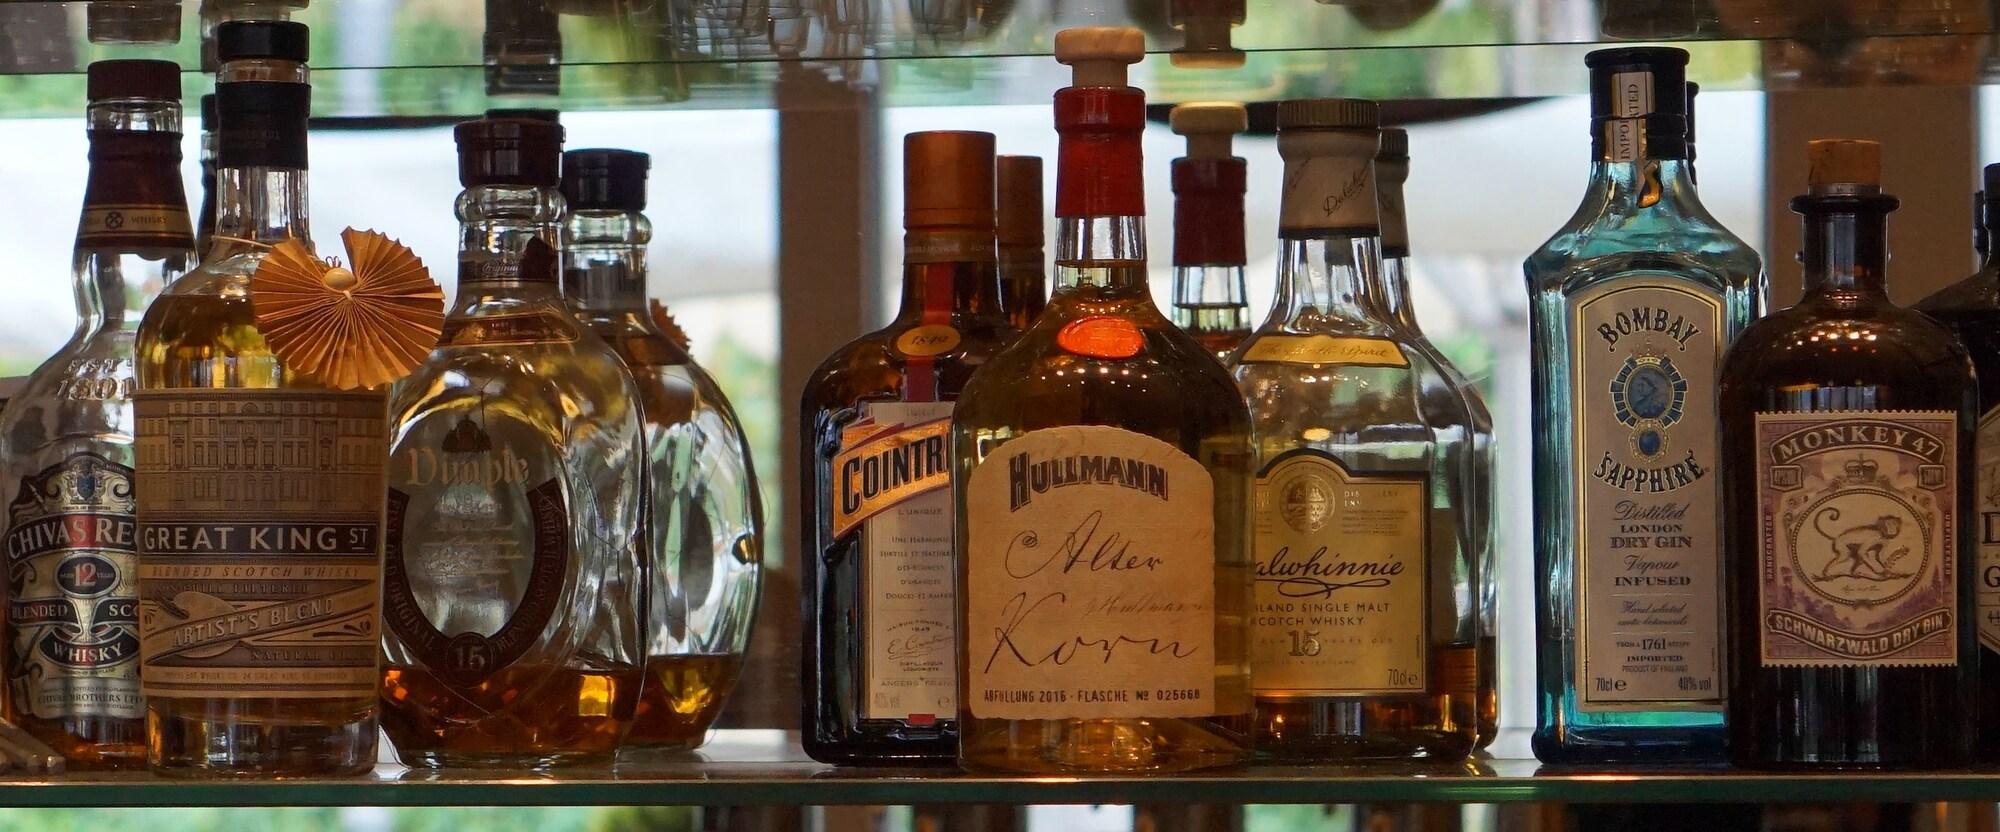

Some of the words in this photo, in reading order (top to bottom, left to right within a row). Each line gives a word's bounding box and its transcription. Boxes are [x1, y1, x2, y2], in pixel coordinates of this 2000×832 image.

[1597, 308, 1700, 352] BOMBAY
[1779, 426, 1908, 460] MONKEY
[1912, 437, 1940, 457] 47
[406, 446, 529, 492] Dimple
[1592, 448, 1705, 494] SAPPHIRE
[1009, 452, 1168, 512] HULLMANN
[1614, 500, 1690, 521] Distilled
[9, 520, 87, 559] CHIVAS
[96, 518, 134, 545] RE
[145, 527, 234, 550] GREAT
[250, 527, 337, 550] KING
[350, 528, 368, 544] ST
[1621, 524, 1682, 533] LONDON
[1005, 510, 1164, 579] Alter
[1610, 536, 1651, 549] DRY
[1655, 536, 1692, 549] GIN
[152, 566, 213, 576] BLENDED
[222, 566, 292, 577] SCOTCH
[303, 566, 359, 577] WHISKY
[1256, 546, 1405, 576] alwhinnie
[1623, 554, 1680, 574] Vapour
[74, 562, 97, 587] 12
[1615, 577, 1691, 586] INFUSED
[12, 604, 68, 618] BLENDED
[1302, 604, 1349, 613] SINGLE
[1357, 603, 1391, 613] MALT
[174, 611, 260, 646] ARTIST'S
[271, 598, 334, 626] BLEND
[984, 592, 1199, 674] Korn
[1254, 617, 1304, 626] COTCH
[1311, 617, 1365, 626] WHISKY
[1288, 630, 1321, 656] 15
[1642, 639, 1666, 650] 1761
[1775, 614, 1889, 655] SCHWARZWALD
[1893, 623, 1920, 645] DRY
[1923, 615, 1943, 632] GIN
[54, 642, 122, 662] WHISKY
[457, 645, 486, 668] 15
[1388, 669, 1407, 685] 70cl
[1597, 678, 1612, 692] 70cl
[1078, 690, 1128, 702] FLASCHE
